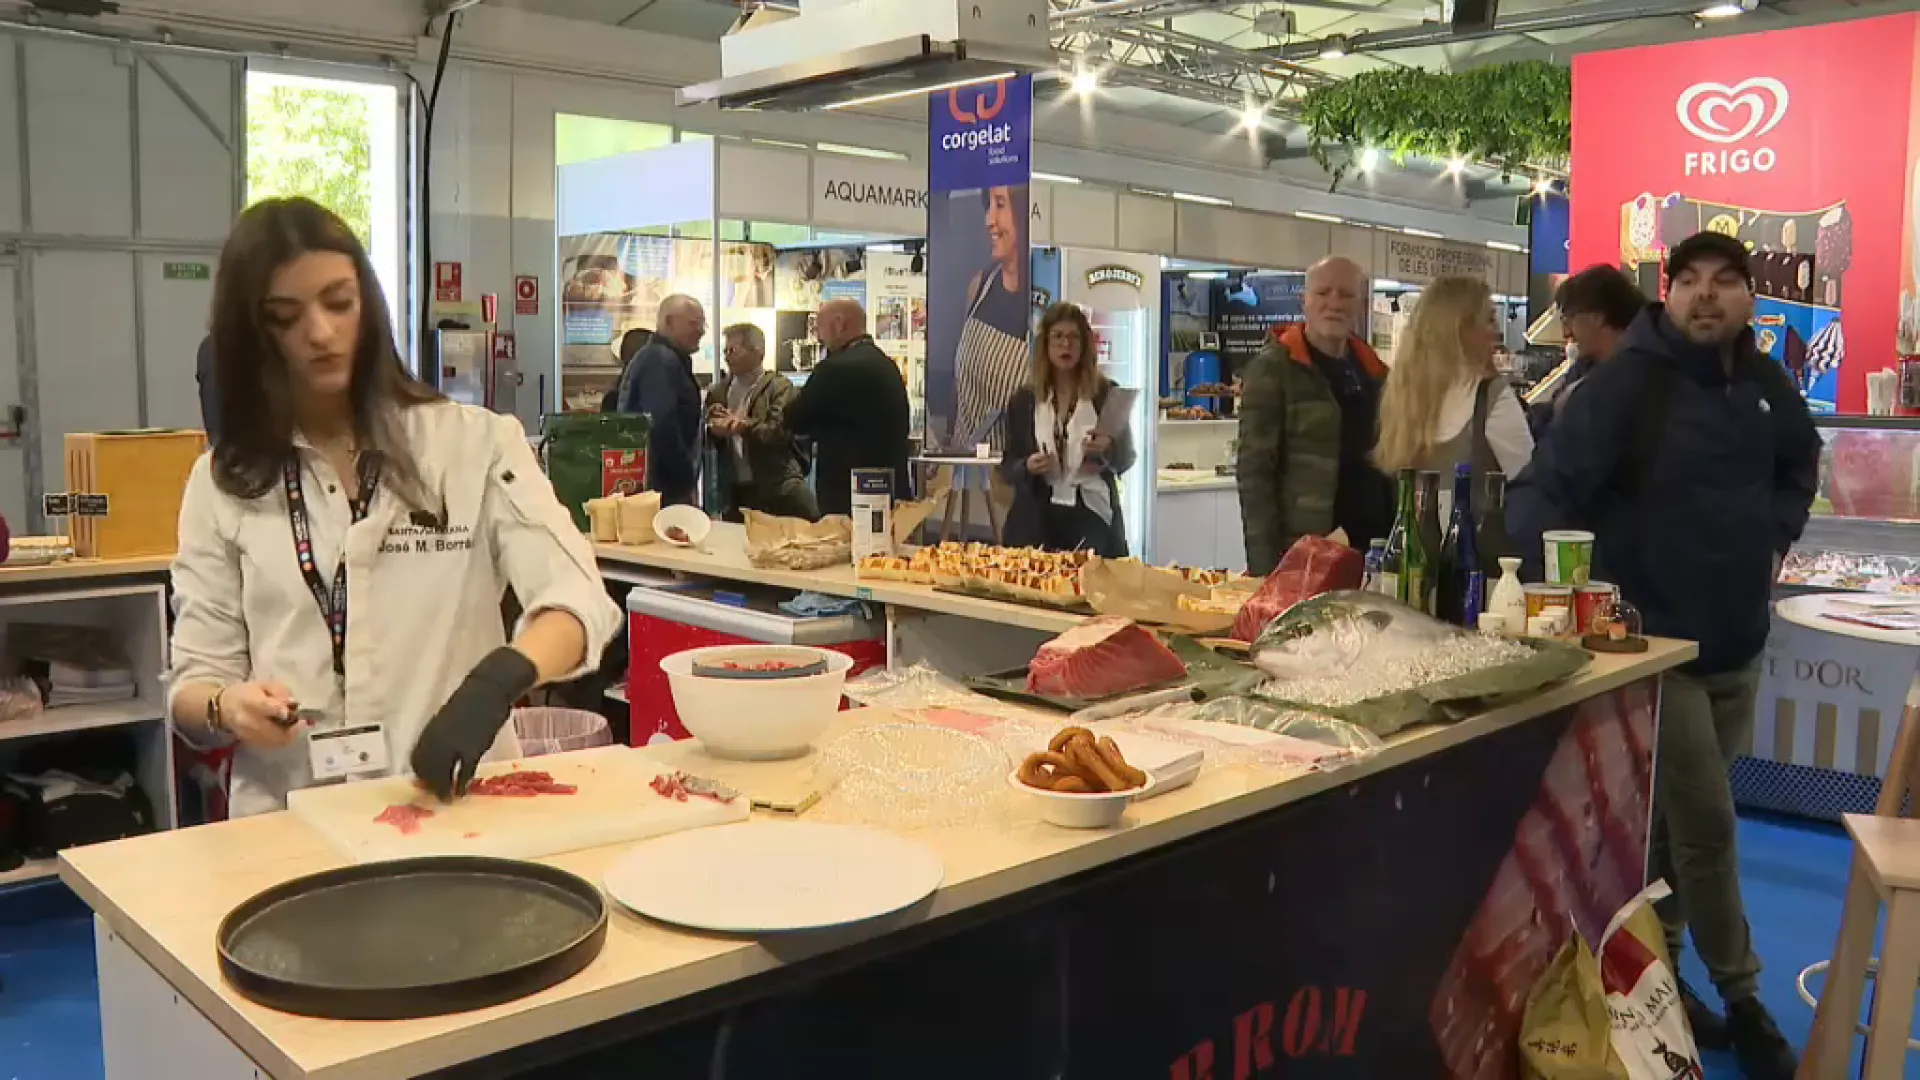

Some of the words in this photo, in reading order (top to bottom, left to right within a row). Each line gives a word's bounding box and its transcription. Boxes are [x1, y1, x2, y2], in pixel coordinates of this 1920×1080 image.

[942, 121, 1012, 151] corgelat
[1683, 146, 1776, 177] FRIGO
[1398, 258, 1411, 273] DE
[377, 537, 409, 553] José
[1794, 658, 1874, 696] D'OR
